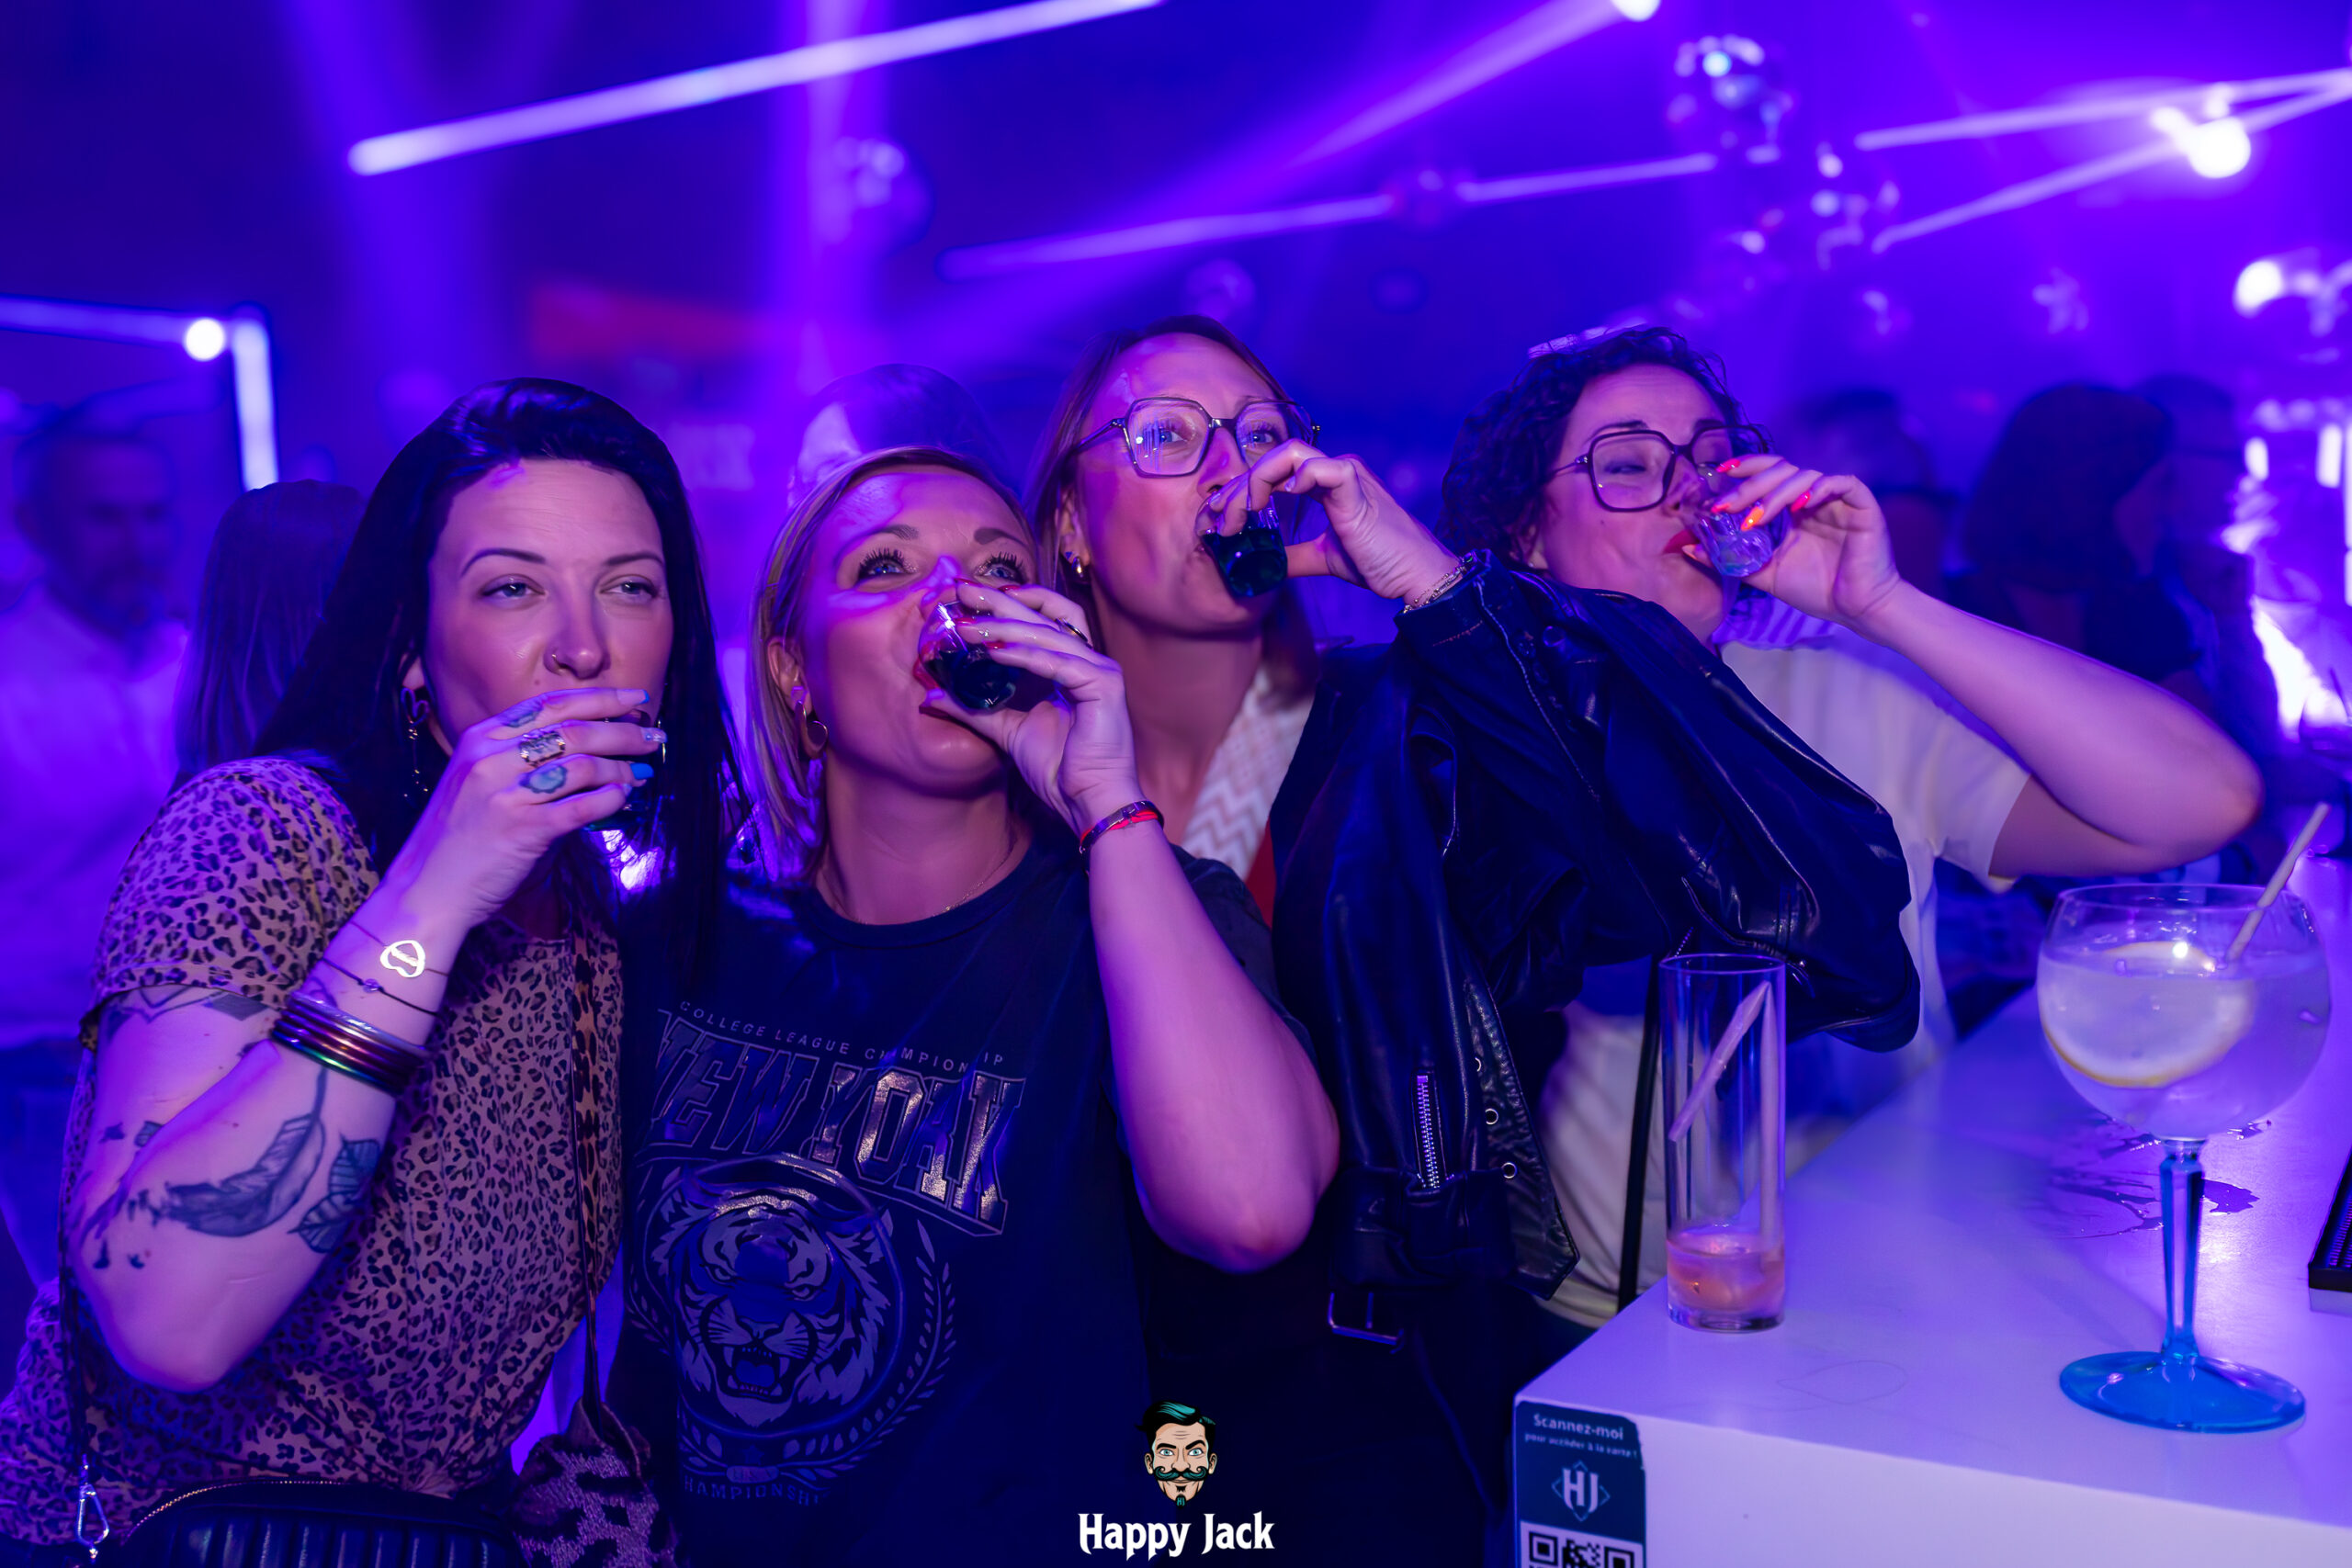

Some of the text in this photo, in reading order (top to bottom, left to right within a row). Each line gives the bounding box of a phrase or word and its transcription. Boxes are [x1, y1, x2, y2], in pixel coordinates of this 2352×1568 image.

[679, 1000, 1003, 1073] COLLEGE LEAGUE CMPIONIP
[1533, 1414, 1623, 1440] Scannez-moi
[1561, 1467, 1600, 1514] HJ
